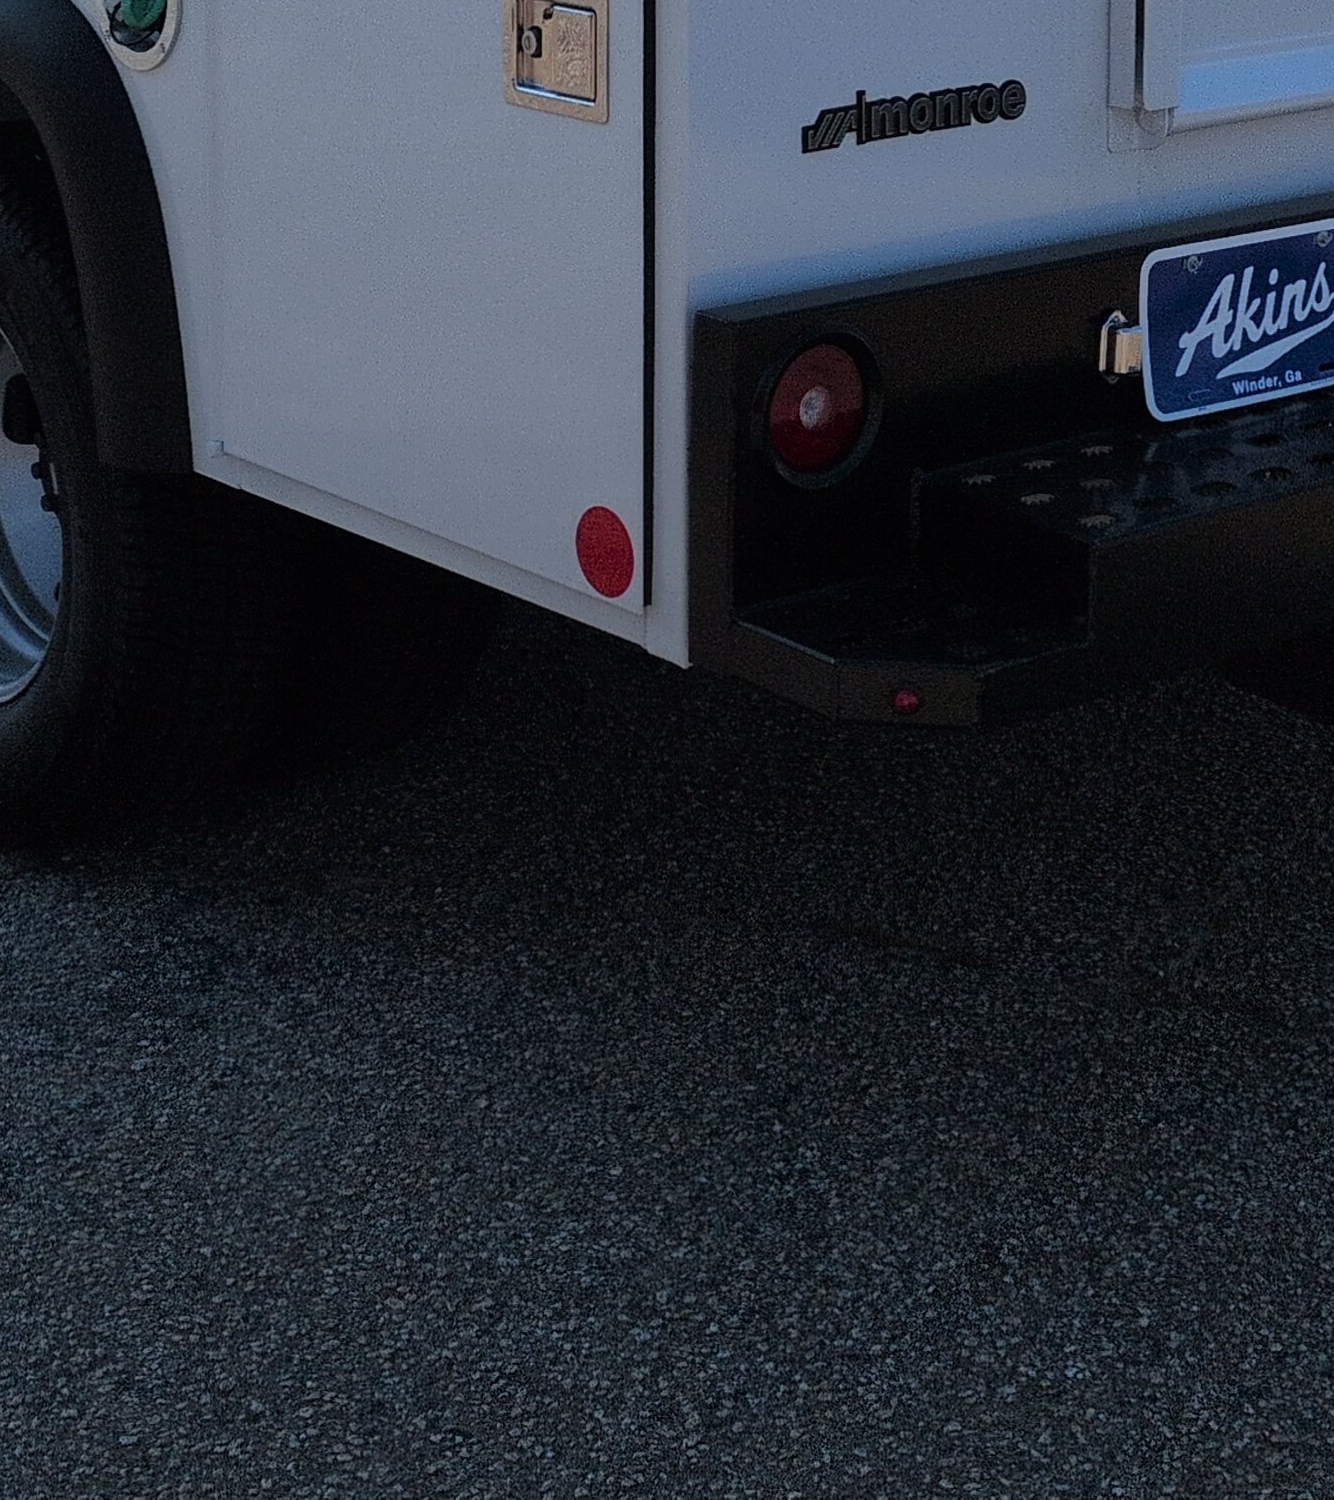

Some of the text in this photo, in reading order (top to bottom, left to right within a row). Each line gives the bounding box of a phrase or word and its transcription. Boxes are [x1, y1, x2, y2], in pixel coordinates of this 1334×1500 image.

[866, 79, 1027, 141] monroe
[1231, 376, 1283, 395] Winder,
[1284, 370, 1303, 383] Ga
